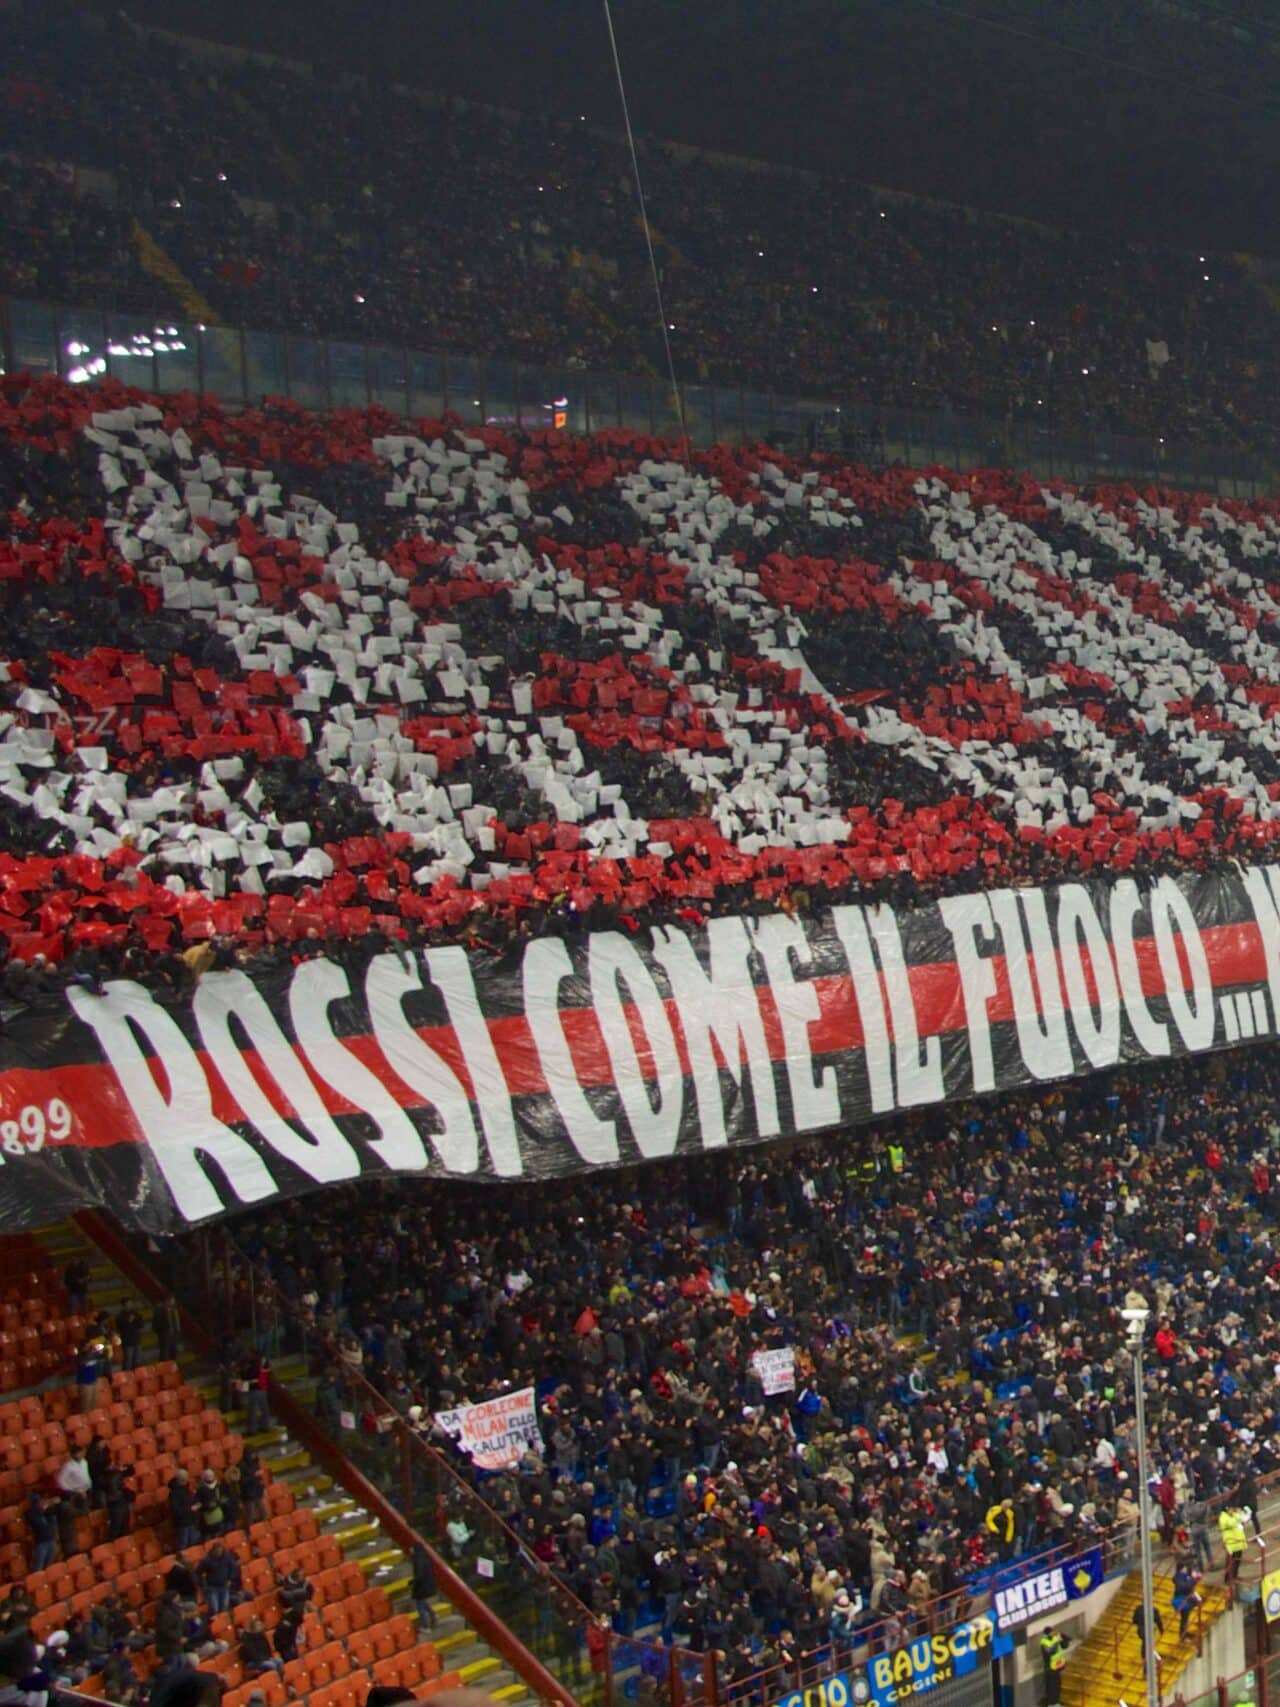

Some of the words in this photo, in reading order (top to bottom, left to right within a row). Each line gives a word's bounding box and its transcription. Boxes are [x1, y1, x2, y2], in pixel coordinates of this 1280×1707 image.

[65, 945, 524, 1221] ROSSI
[522, 913, 841, 1164] COME
[832, 901, 945, 1113] IL
[0, 1097, 72, 1164] 899
[440, 1412, 461, 1426] DA
[995, 1567, 1065, 1617] INTER
[874, 1619, 994, 1689] BAUSCIA
